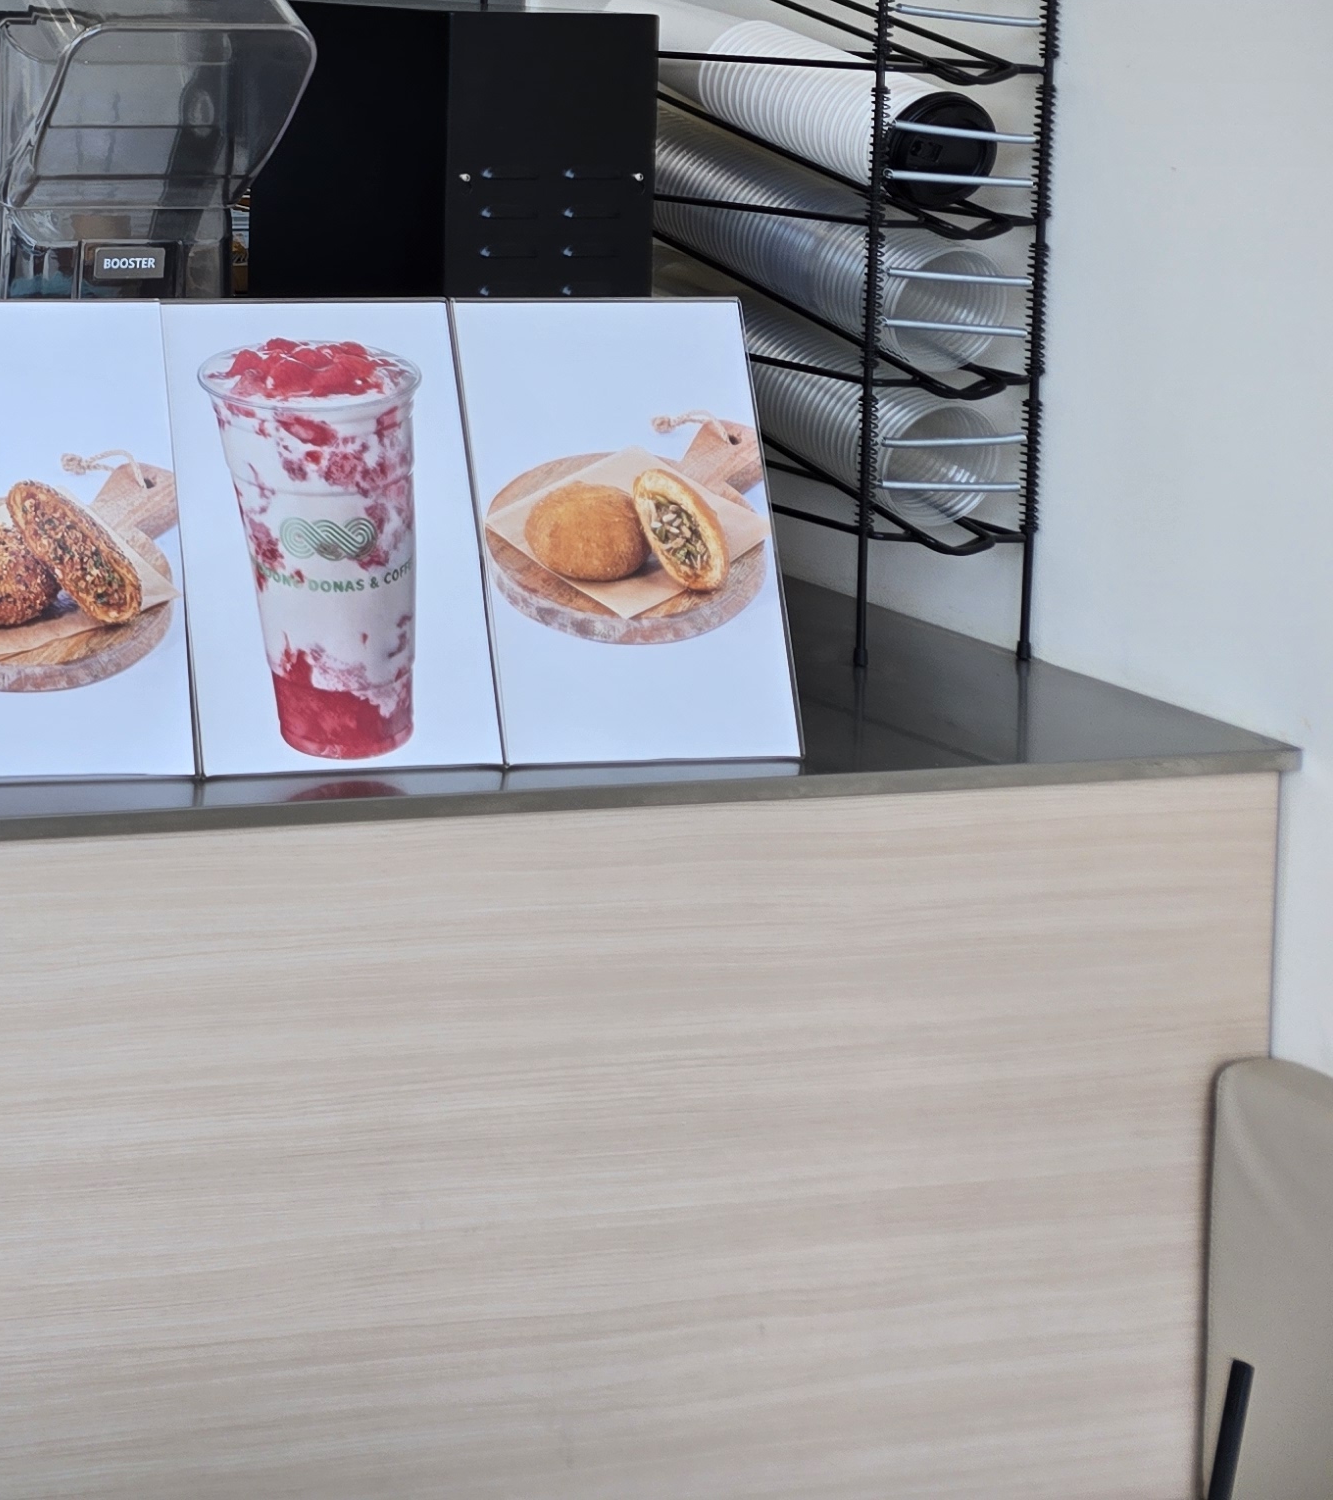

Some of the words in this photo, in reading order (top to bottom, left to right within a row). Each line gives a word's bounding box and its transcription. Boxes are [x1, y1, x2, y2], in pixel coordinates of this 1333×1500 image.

[103, 257, 156, 269] BOOSTER
[308, 578, 365, 593] DONAS
[370, 576, 379, 589] &
